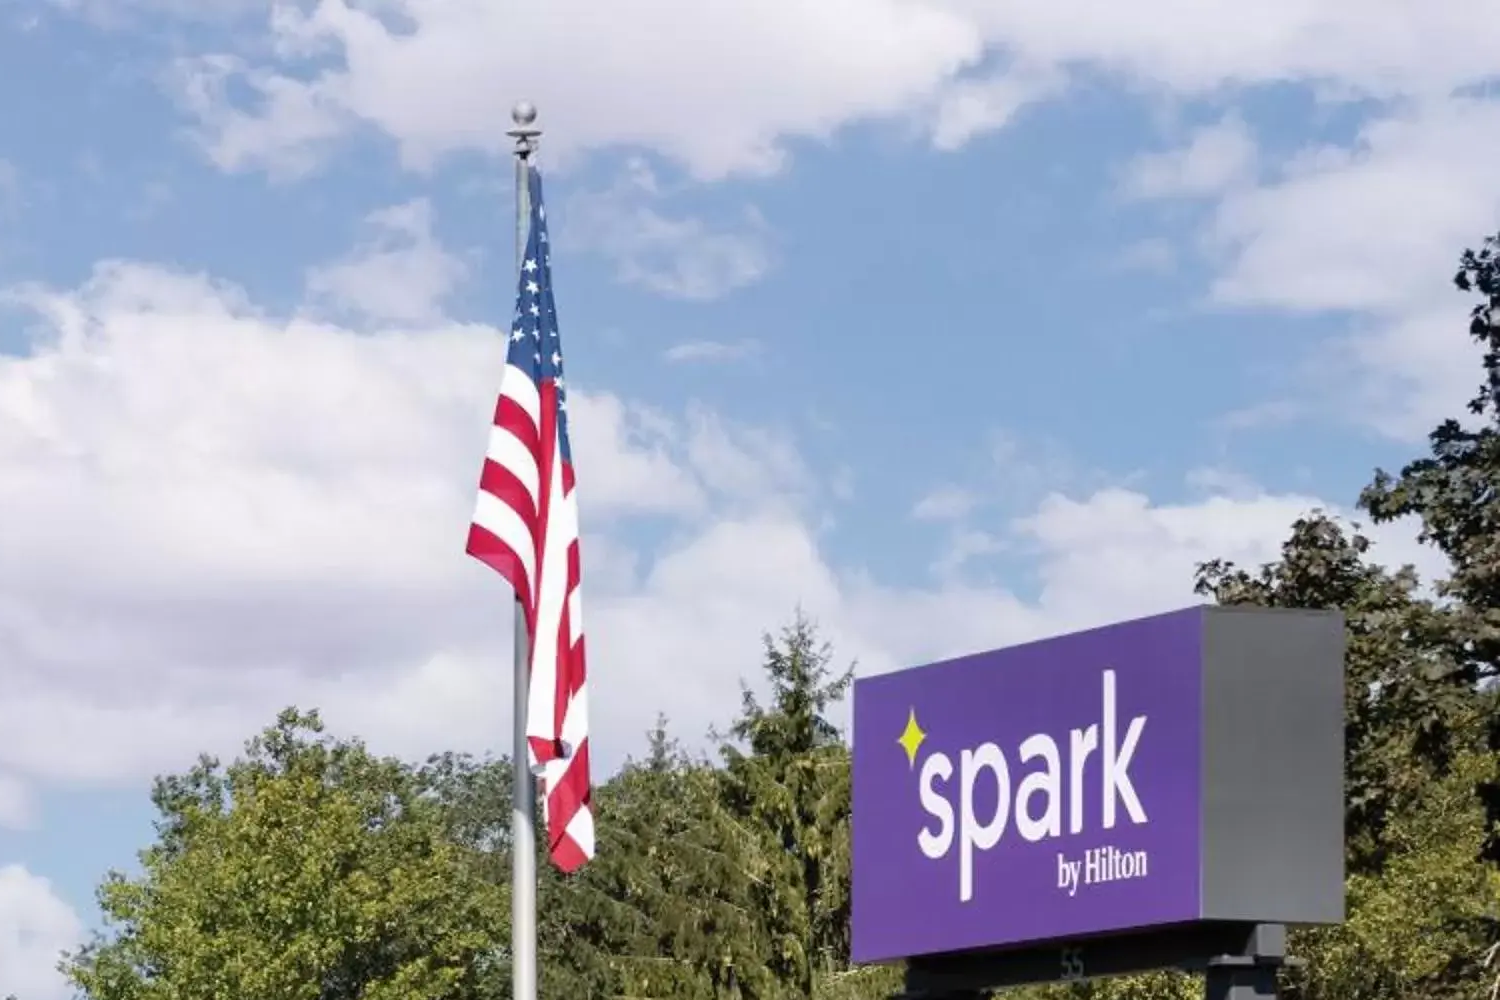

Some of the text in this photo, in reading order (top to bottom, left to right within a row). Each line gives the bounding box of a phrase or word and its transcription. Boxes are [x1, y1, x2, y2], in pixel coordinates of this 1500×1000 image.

[917, 669, 1147, 902] spark
[1057, 845, 1148, 897] by Hilton
